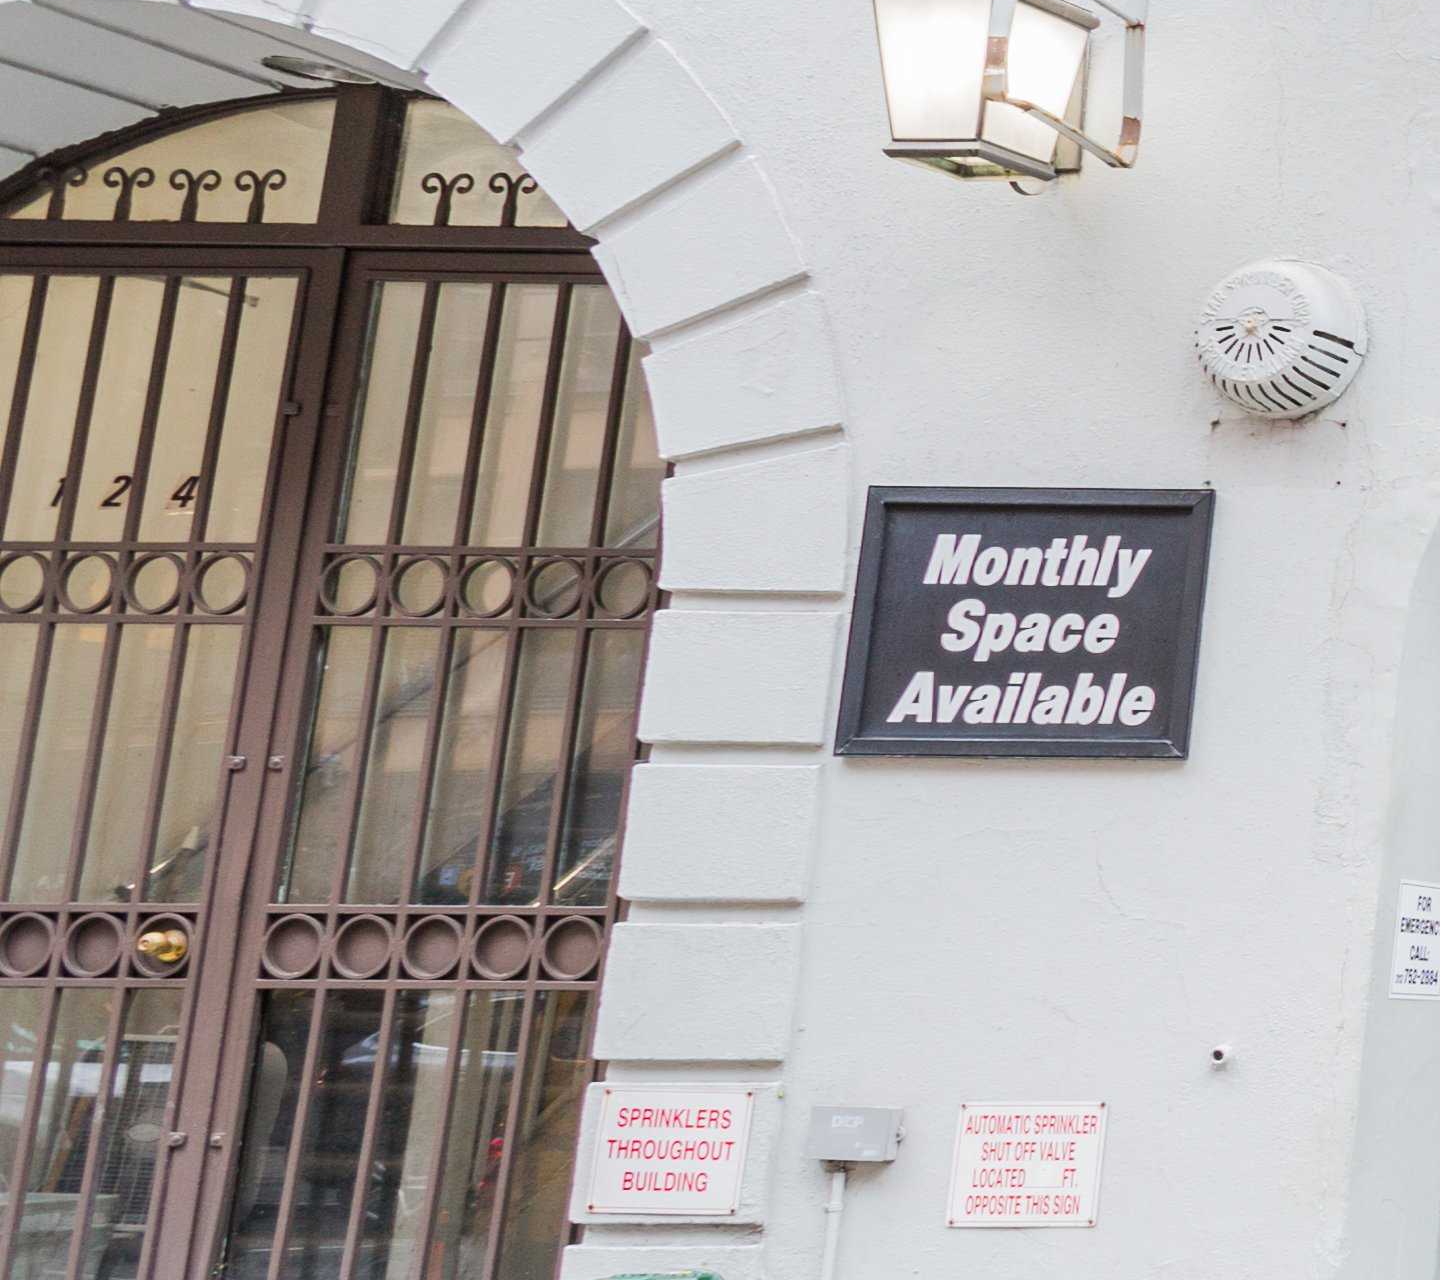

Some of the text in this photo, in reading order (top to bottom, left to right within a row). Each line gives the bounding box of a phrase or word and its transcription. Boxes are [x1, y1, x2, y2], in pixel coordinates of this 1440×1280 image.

[922, 534, 1152, 598] Monthly
[940, 598, 1120, 662] Space
[886, 671, 1156, 726] Available
[1417, 895, 1432, 912] FOR
[617, 1107, 732, 1129] SPRINKLERS
[965, 1115, 1097, 1134] AUTOMATIC SPRINKLER
[607, 1140, 735, 1160] THROUGHOUT
[982, 1142, 1076, 1161] SHUT OFF VALVE
[622, 1172, 708, 1192] BUILDING
[972, 1169, 1078, 1188] LOCATED FT.
[965, 1195, 1081, 1215] OPPOSITE THIS SIGN
